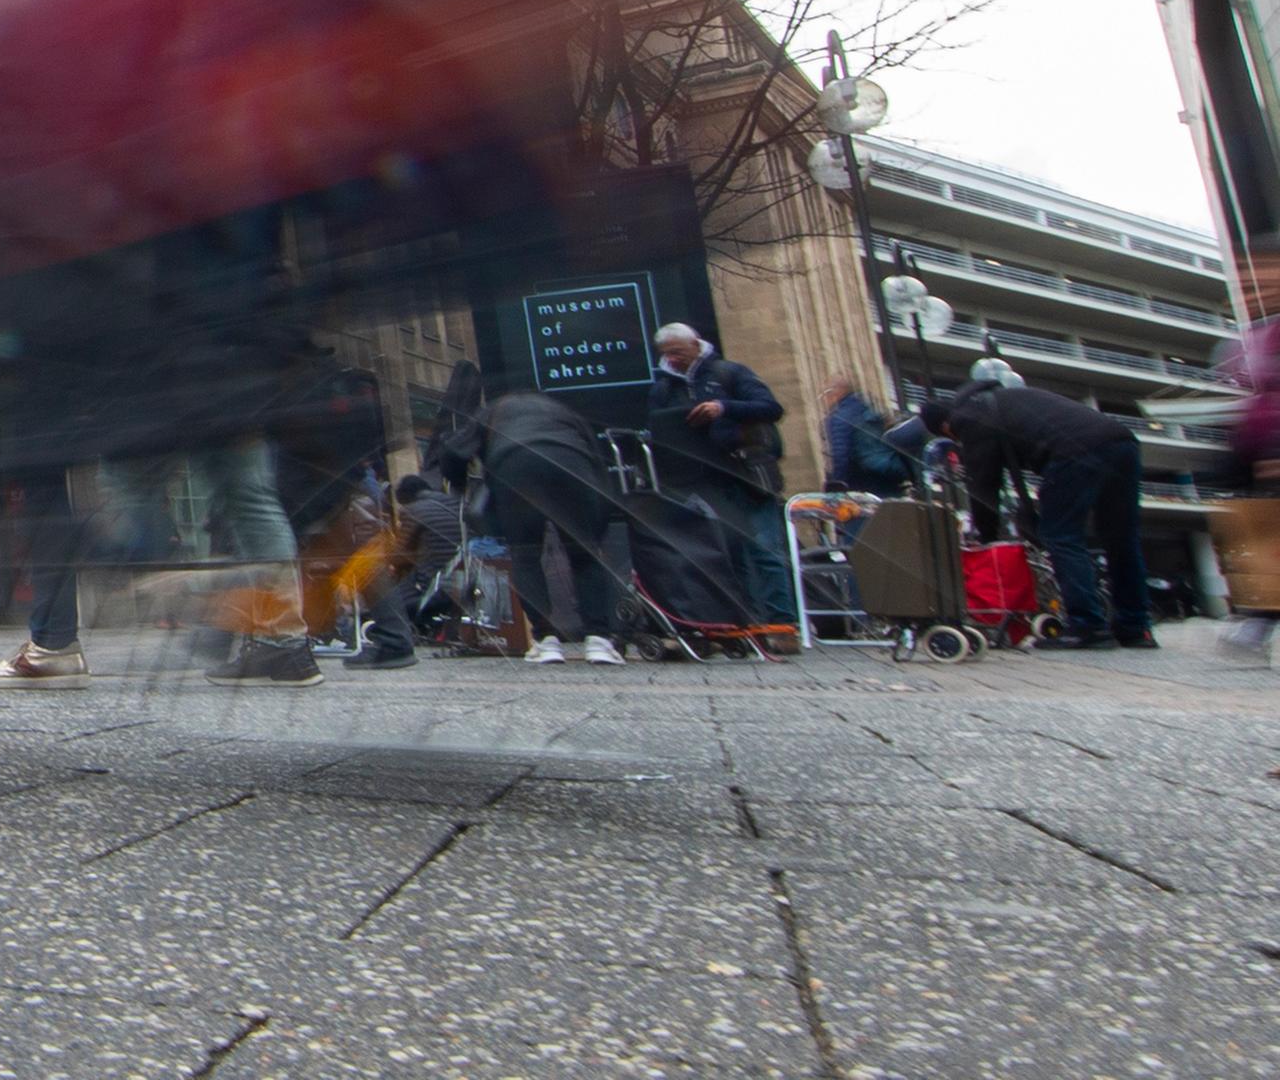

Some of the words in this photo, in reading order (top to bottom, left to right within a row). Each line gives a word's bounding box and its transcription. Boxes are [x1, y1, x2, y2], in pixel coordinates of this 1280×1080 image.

[538, 296, 625, 315] museum
[541, 321, 562, 336] of
[544, 340, 628, 357] modern
[549, 363, 607, 379] ahrts
